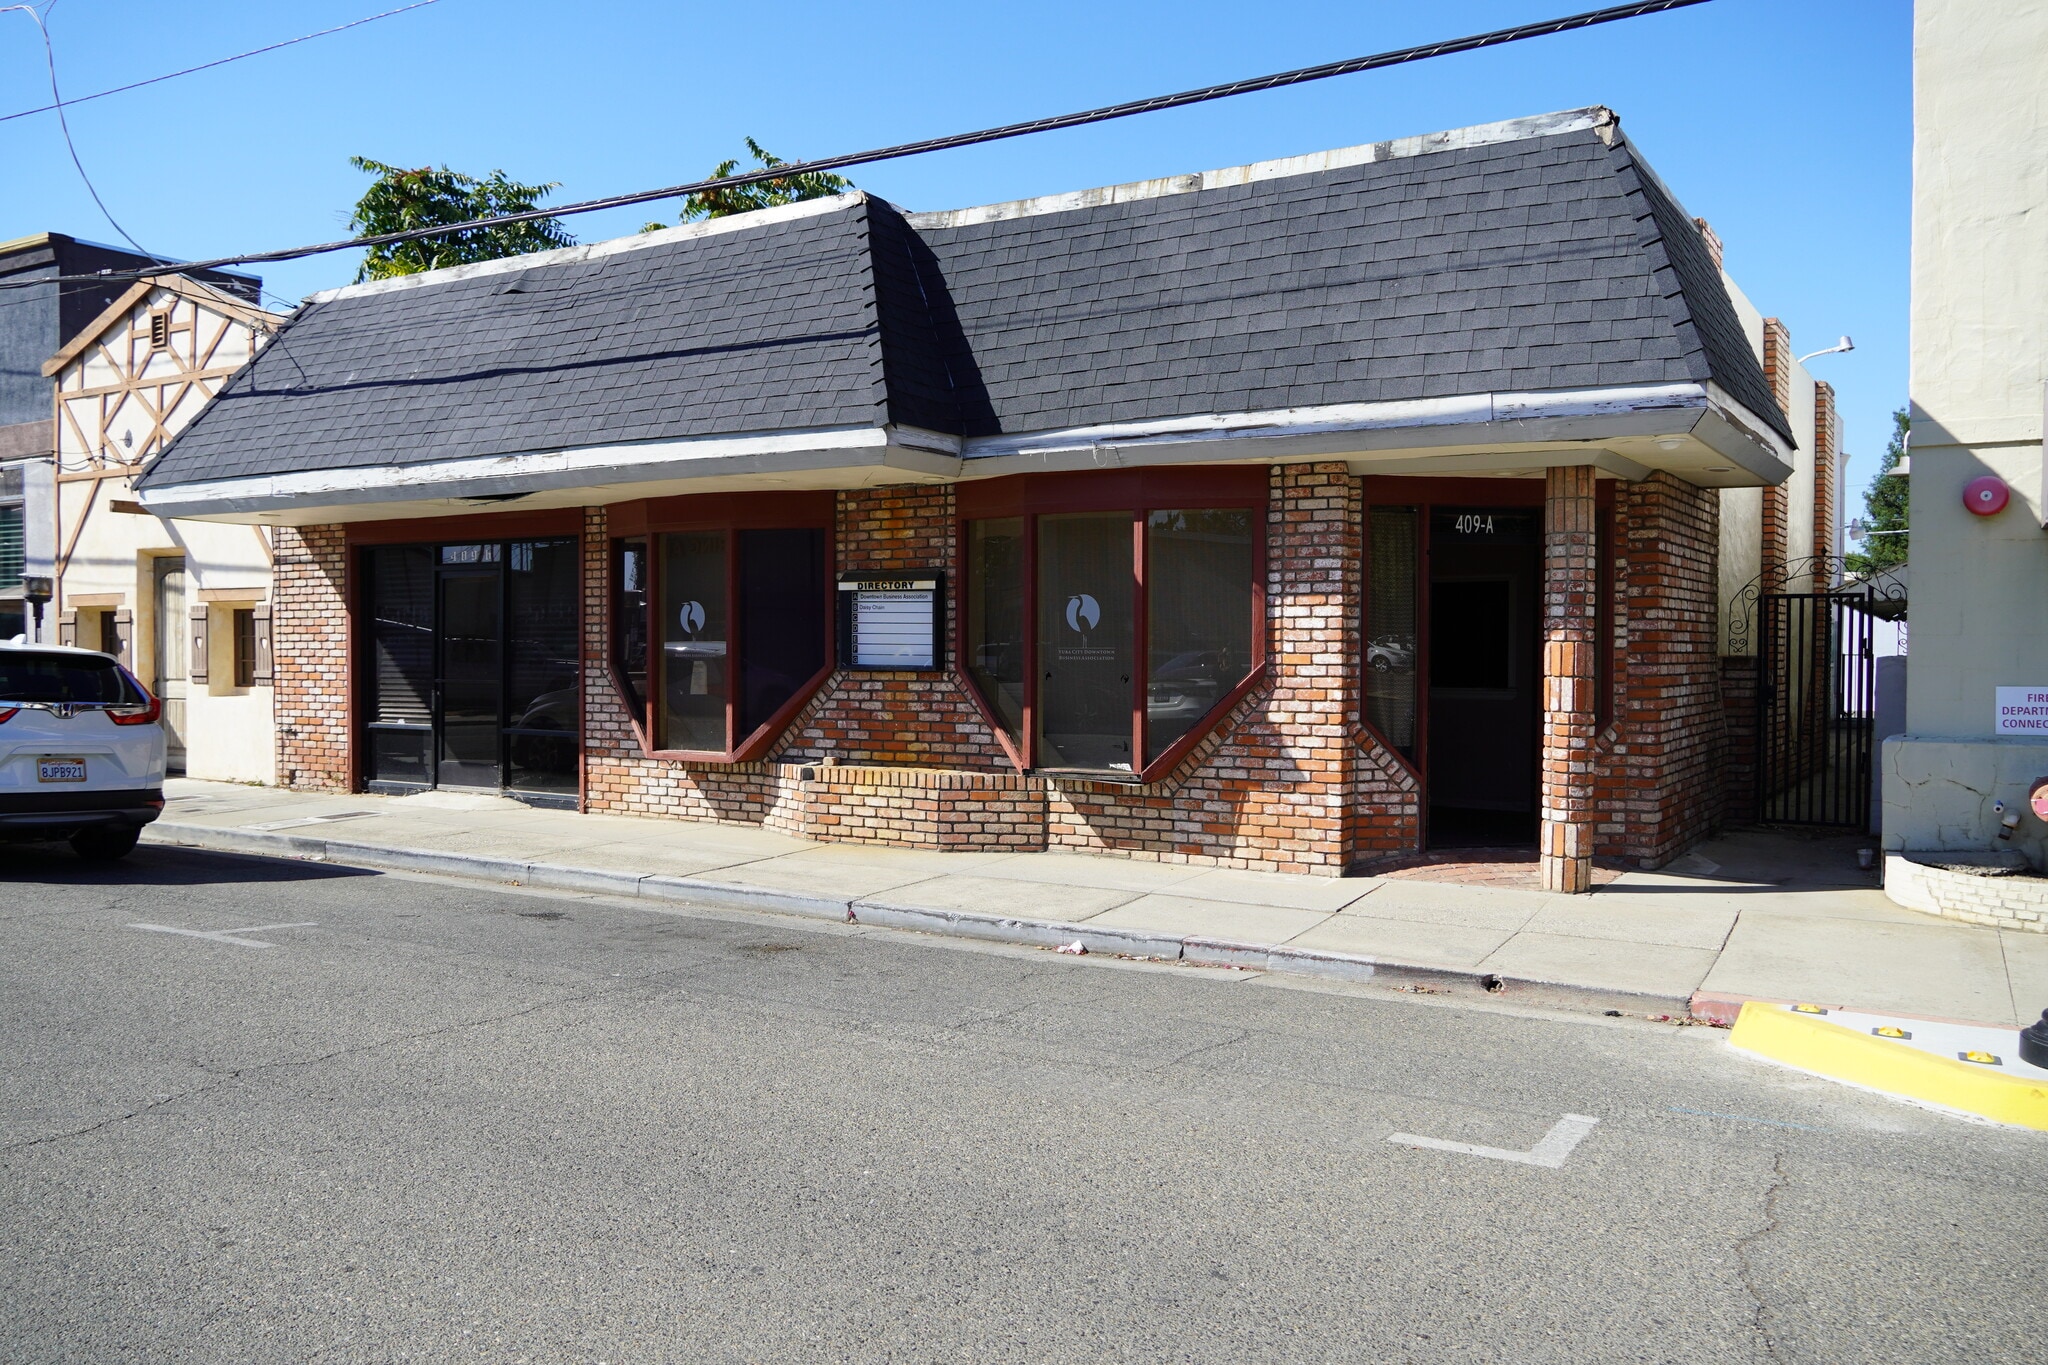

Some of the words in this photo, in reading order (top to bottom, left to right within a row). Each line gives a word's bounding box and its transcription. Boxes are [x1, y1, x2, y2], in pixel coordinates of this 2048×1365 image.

[1455, 514, 1494, 534] 409-A
[857, 581, 915, 590] DIRECTORY
[2002, 706, 2048, 716] DEPART
[41, 766, 84, 778] 8JPB921
